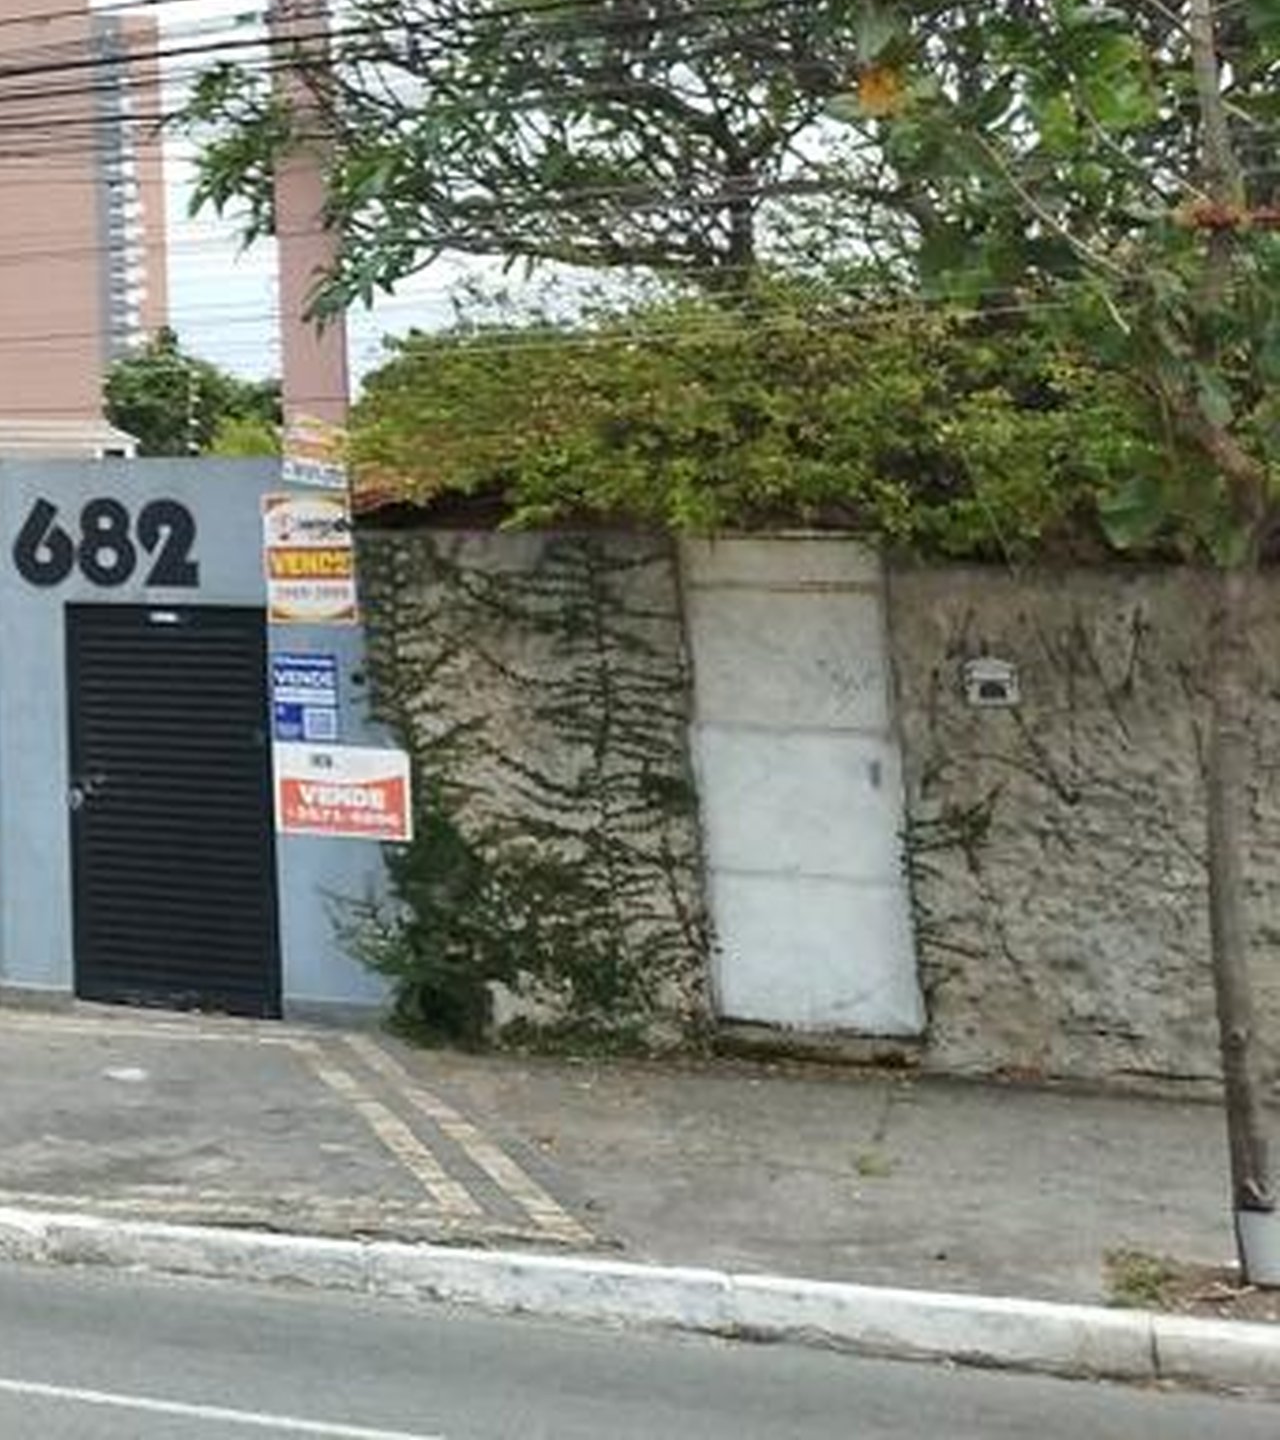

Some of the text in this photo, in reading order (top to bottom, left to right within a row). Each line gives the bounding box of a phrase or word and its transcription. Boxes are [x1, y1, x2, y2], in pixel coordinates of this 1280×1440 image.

[13, 497, 199, 588] 682
[273, 670, 335, 688] VENDE
[298, 781, 385, 809] VENDE
